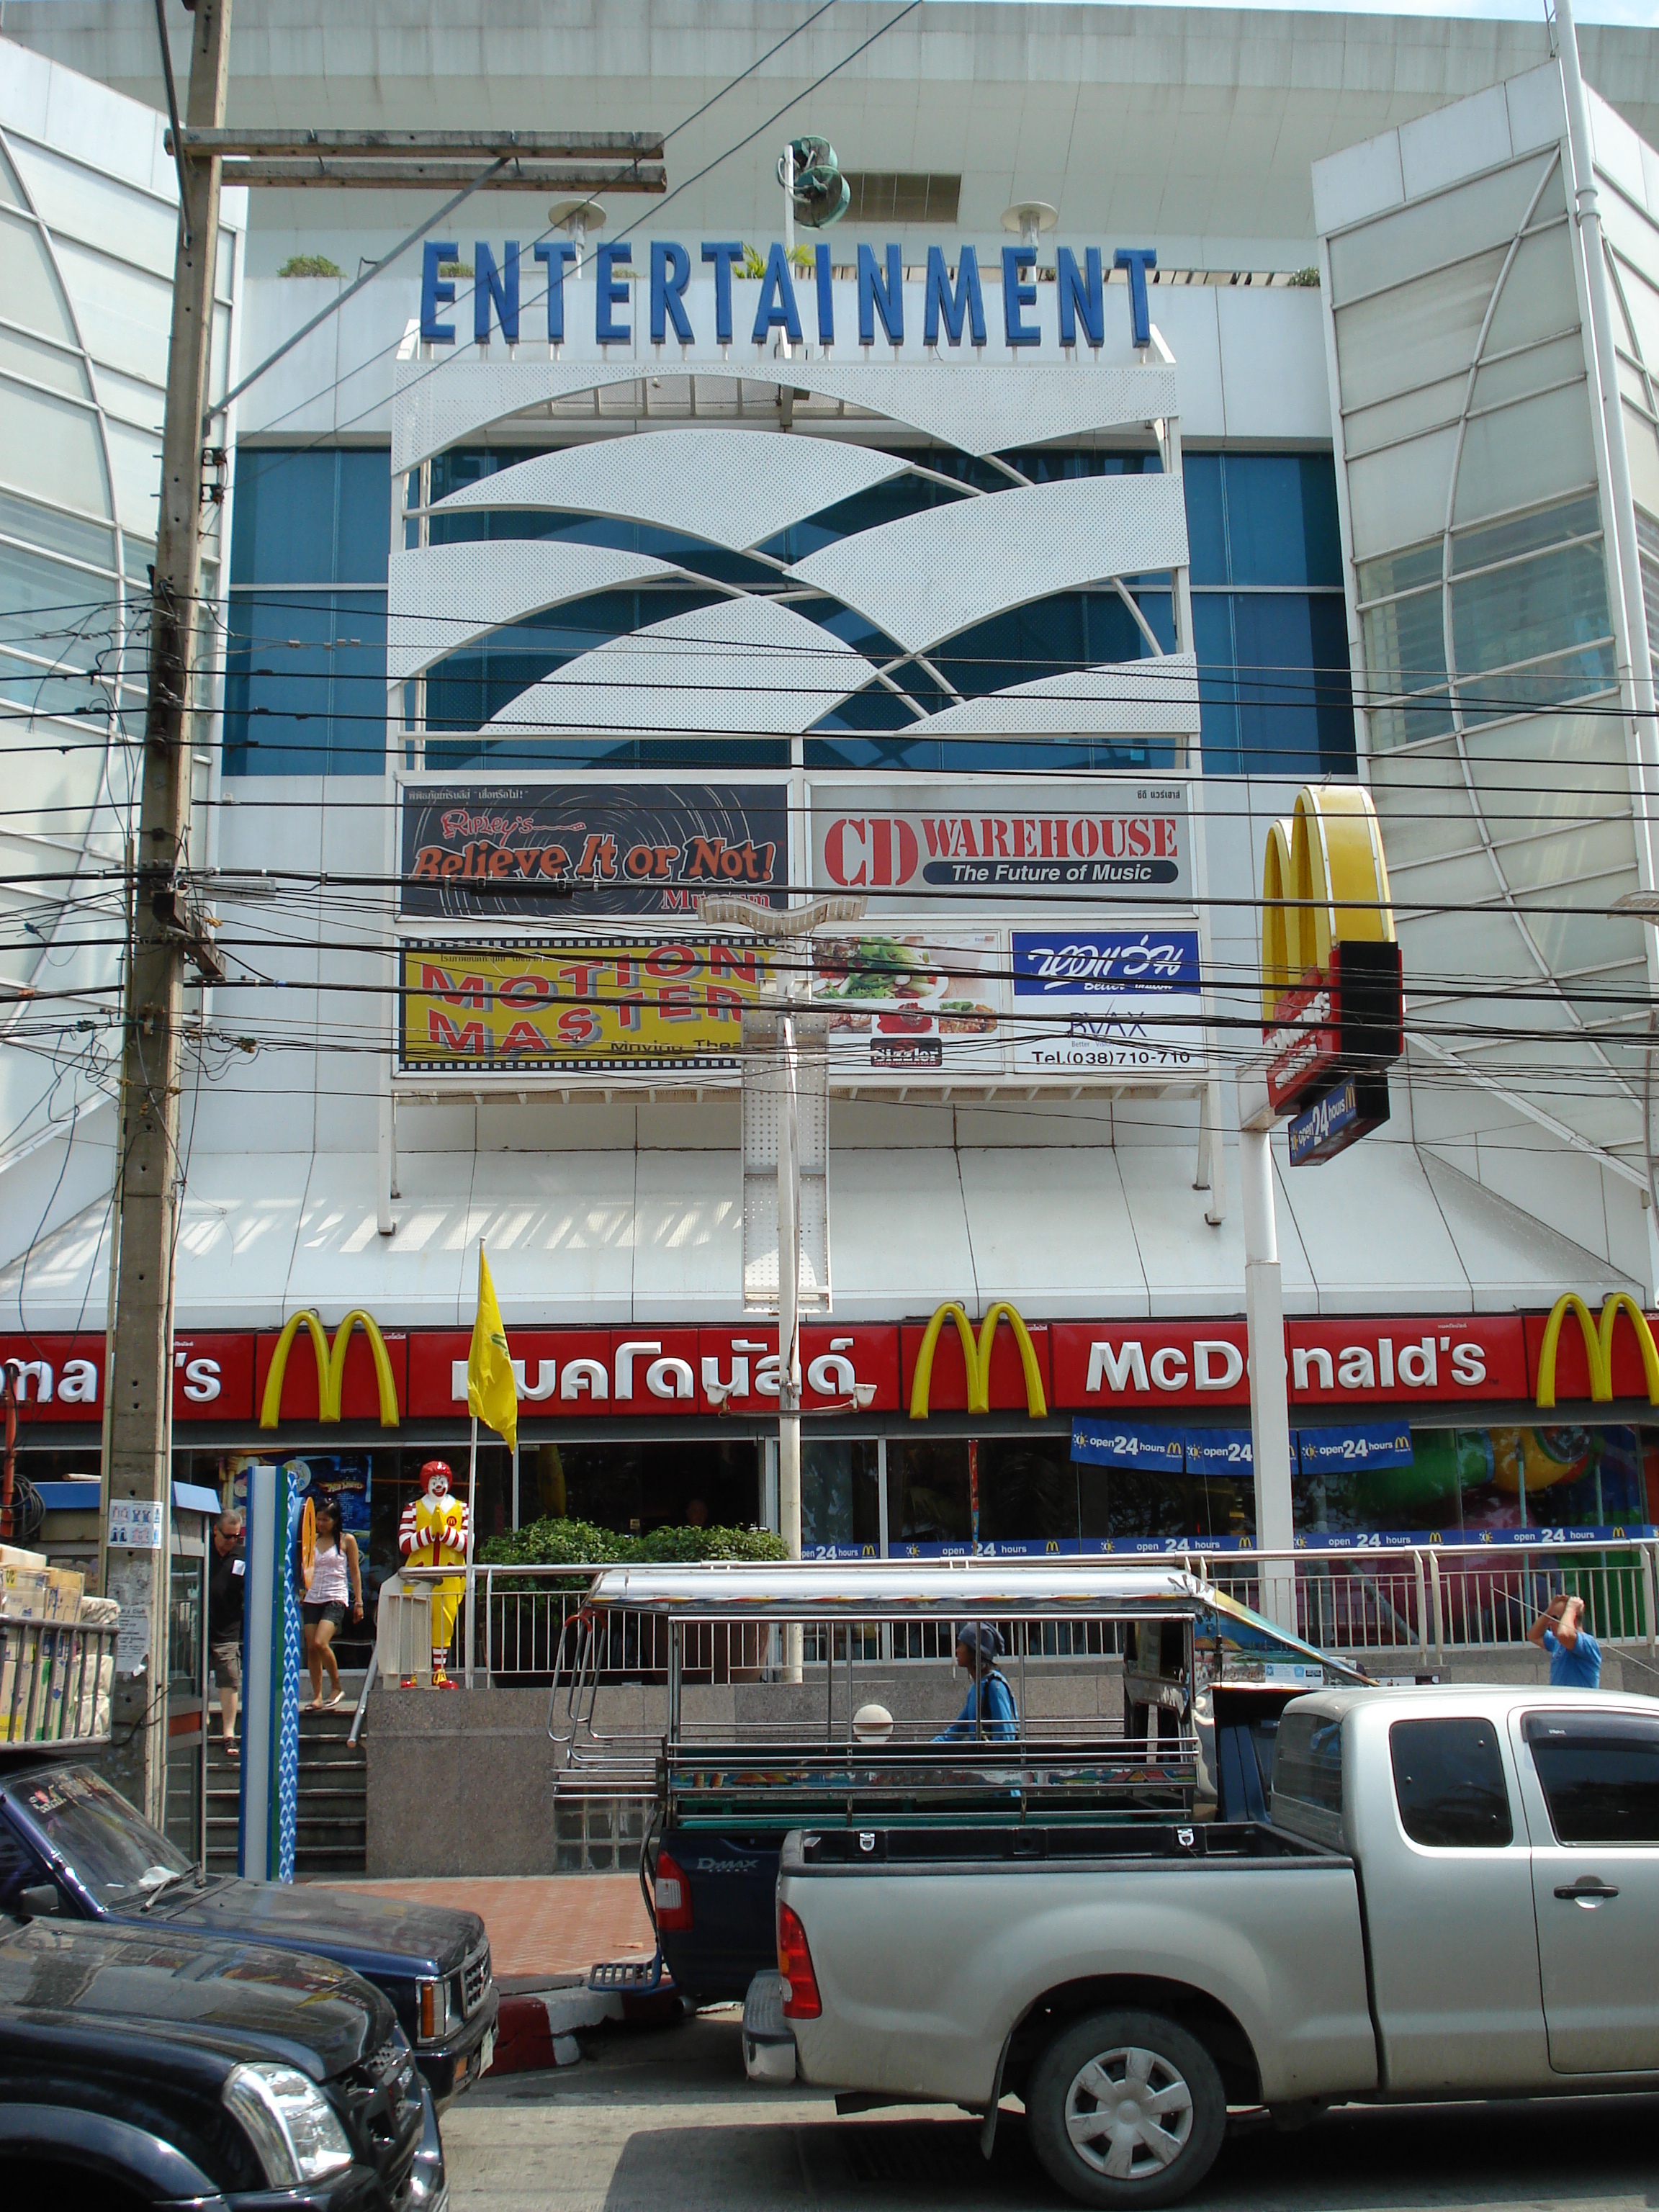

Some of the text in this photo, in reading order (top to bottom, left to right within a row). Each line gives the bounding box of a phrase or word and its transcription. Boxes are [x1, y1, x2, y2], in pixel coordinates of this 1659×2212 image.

[420, 240, 1158, 346] ENTERTAINMENT
[413, 833, 777, 884] Believe It or Not!
[824, 818, 1177, 886] CD WAREHOUSE
[953, 864, 1152, 881] The Future of Music
[422, 944, 760, 1010] MOTION
[428, 984, 742, 1056] MASTER
[1298, 1098, 1345, 1146] open 24 hours
[1085, 1336, 1488, 1391] McDnald's
[1089, 1435, 1166, 1456] open 24 hours
[1203, 1443, 1253, 1462] open 24
[1319, 1439, 1393, 1459] open 24 hours
[1136, 1538, 1220, 1552] open 24 hours
[1328, 1533, 1411, 1547] open 24 hours
[1514, 1528, 1595, 1543] open 24 hours
[801, 1545, 859, 1560] pen 24 hours
[942, 1542, 1028, 1557] open 24 hours
